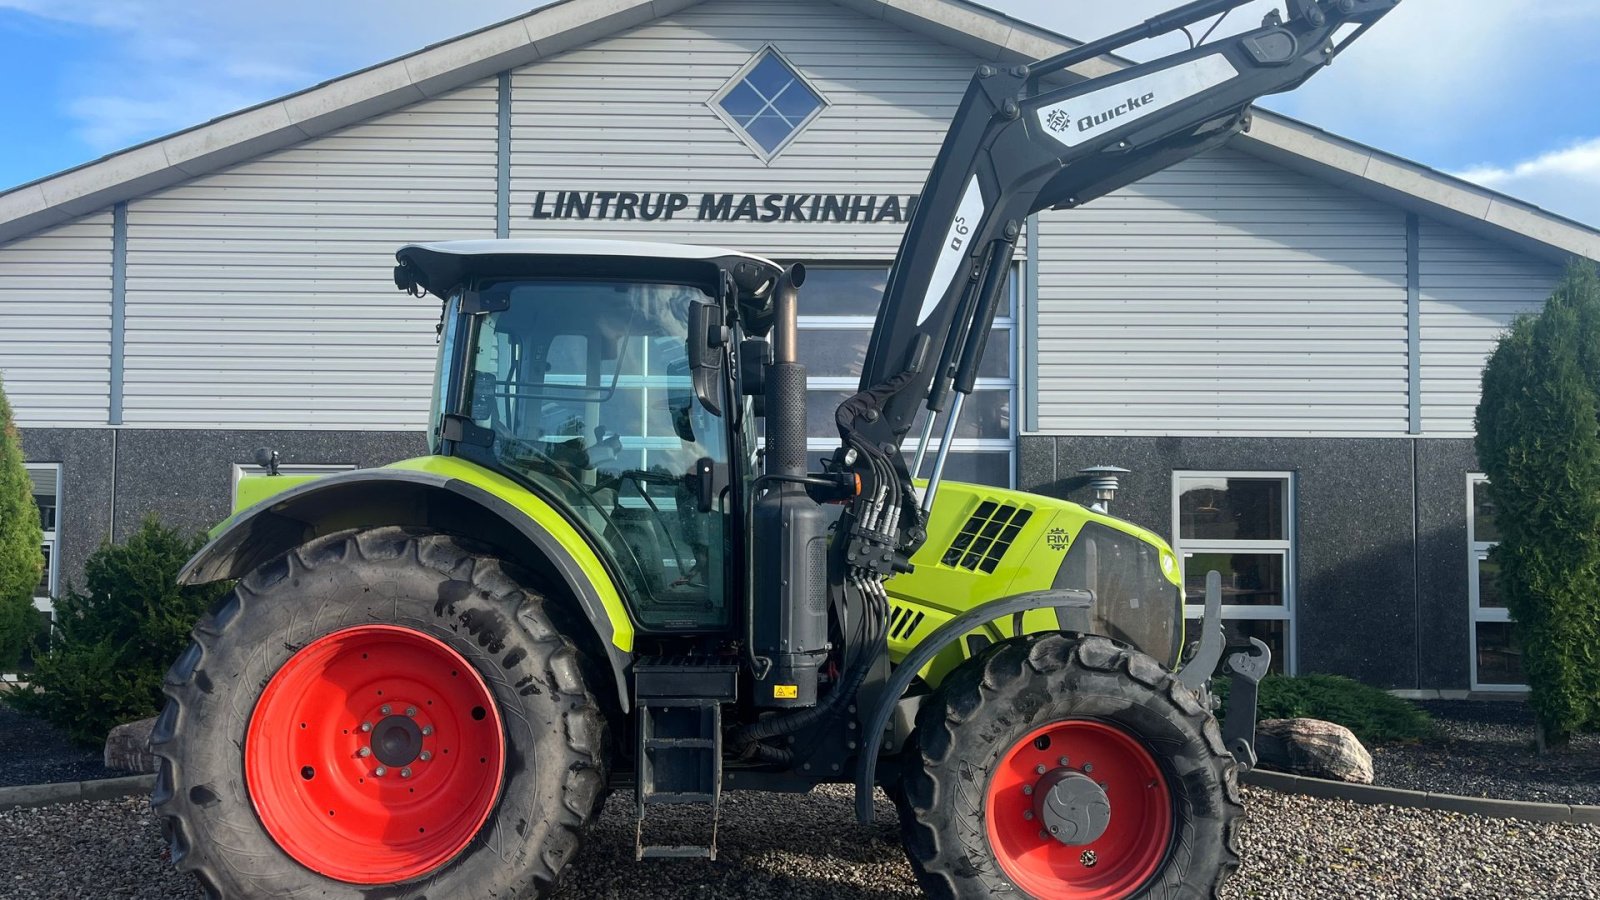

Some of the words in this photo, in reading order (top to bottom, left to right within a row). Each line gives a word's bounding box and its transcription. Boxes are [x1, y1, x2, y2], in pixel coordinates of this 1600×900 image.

[1077, 92, 1154, 133] Quicke
[532, 191, 689, 221] LINTRUP
[1047, 534, 1069, 544] RM
